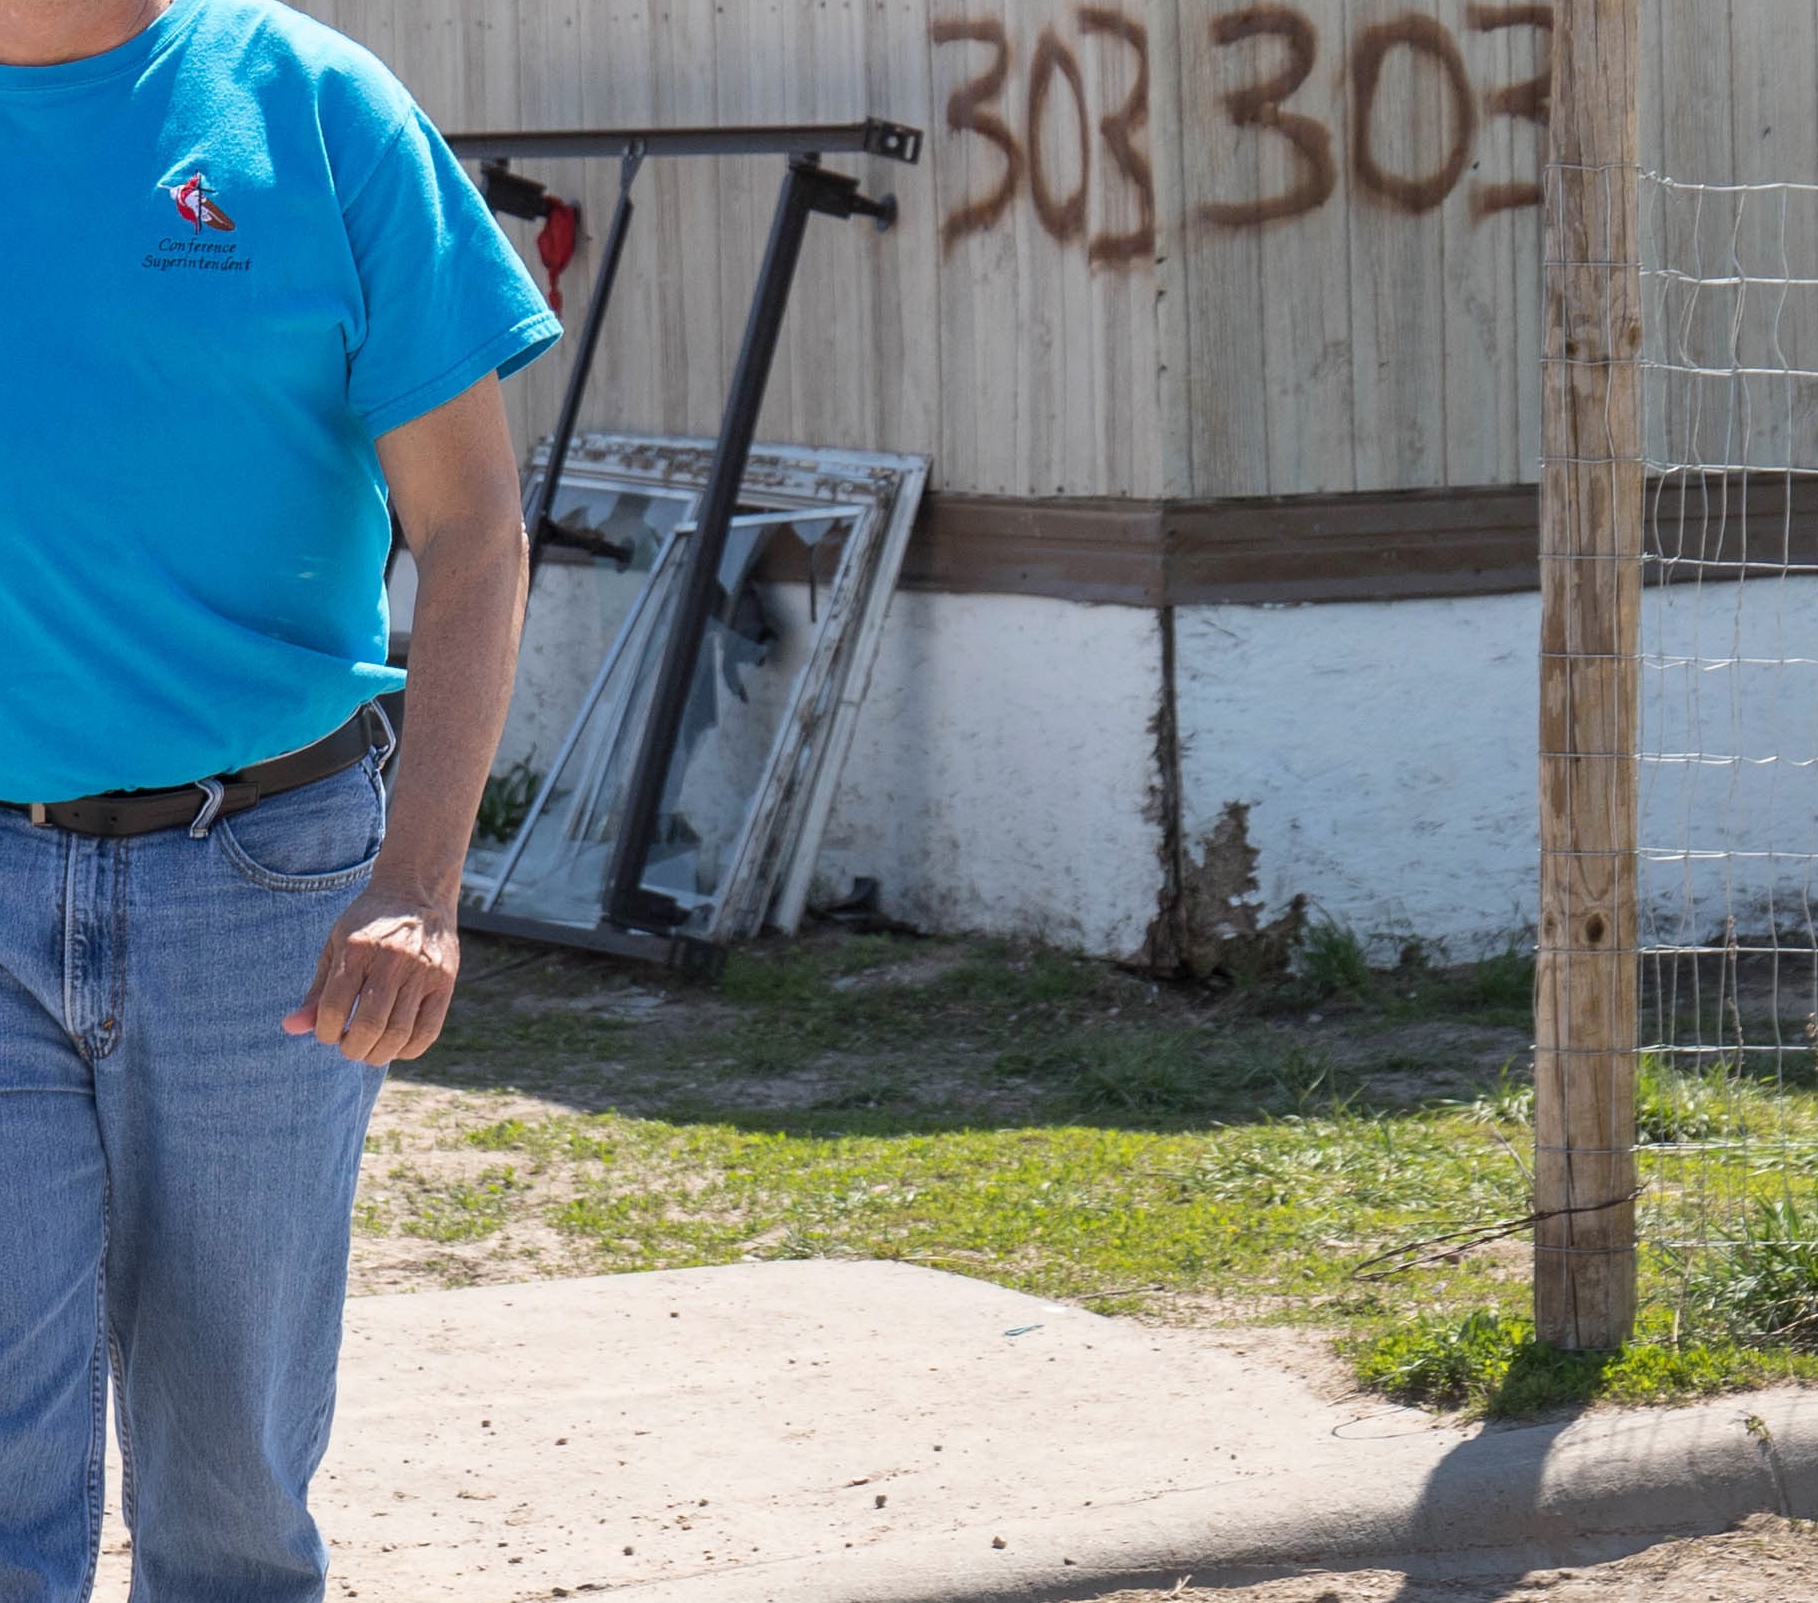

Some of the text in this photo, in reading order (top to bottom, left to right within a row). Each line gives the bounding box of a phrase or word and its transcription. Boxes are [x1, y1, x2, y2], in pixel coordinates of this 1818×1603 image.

[930, 4, 1156, 268] 303
[158, 237, 237, 253] Conference
[142, 254, 252, 272] Superintendent
